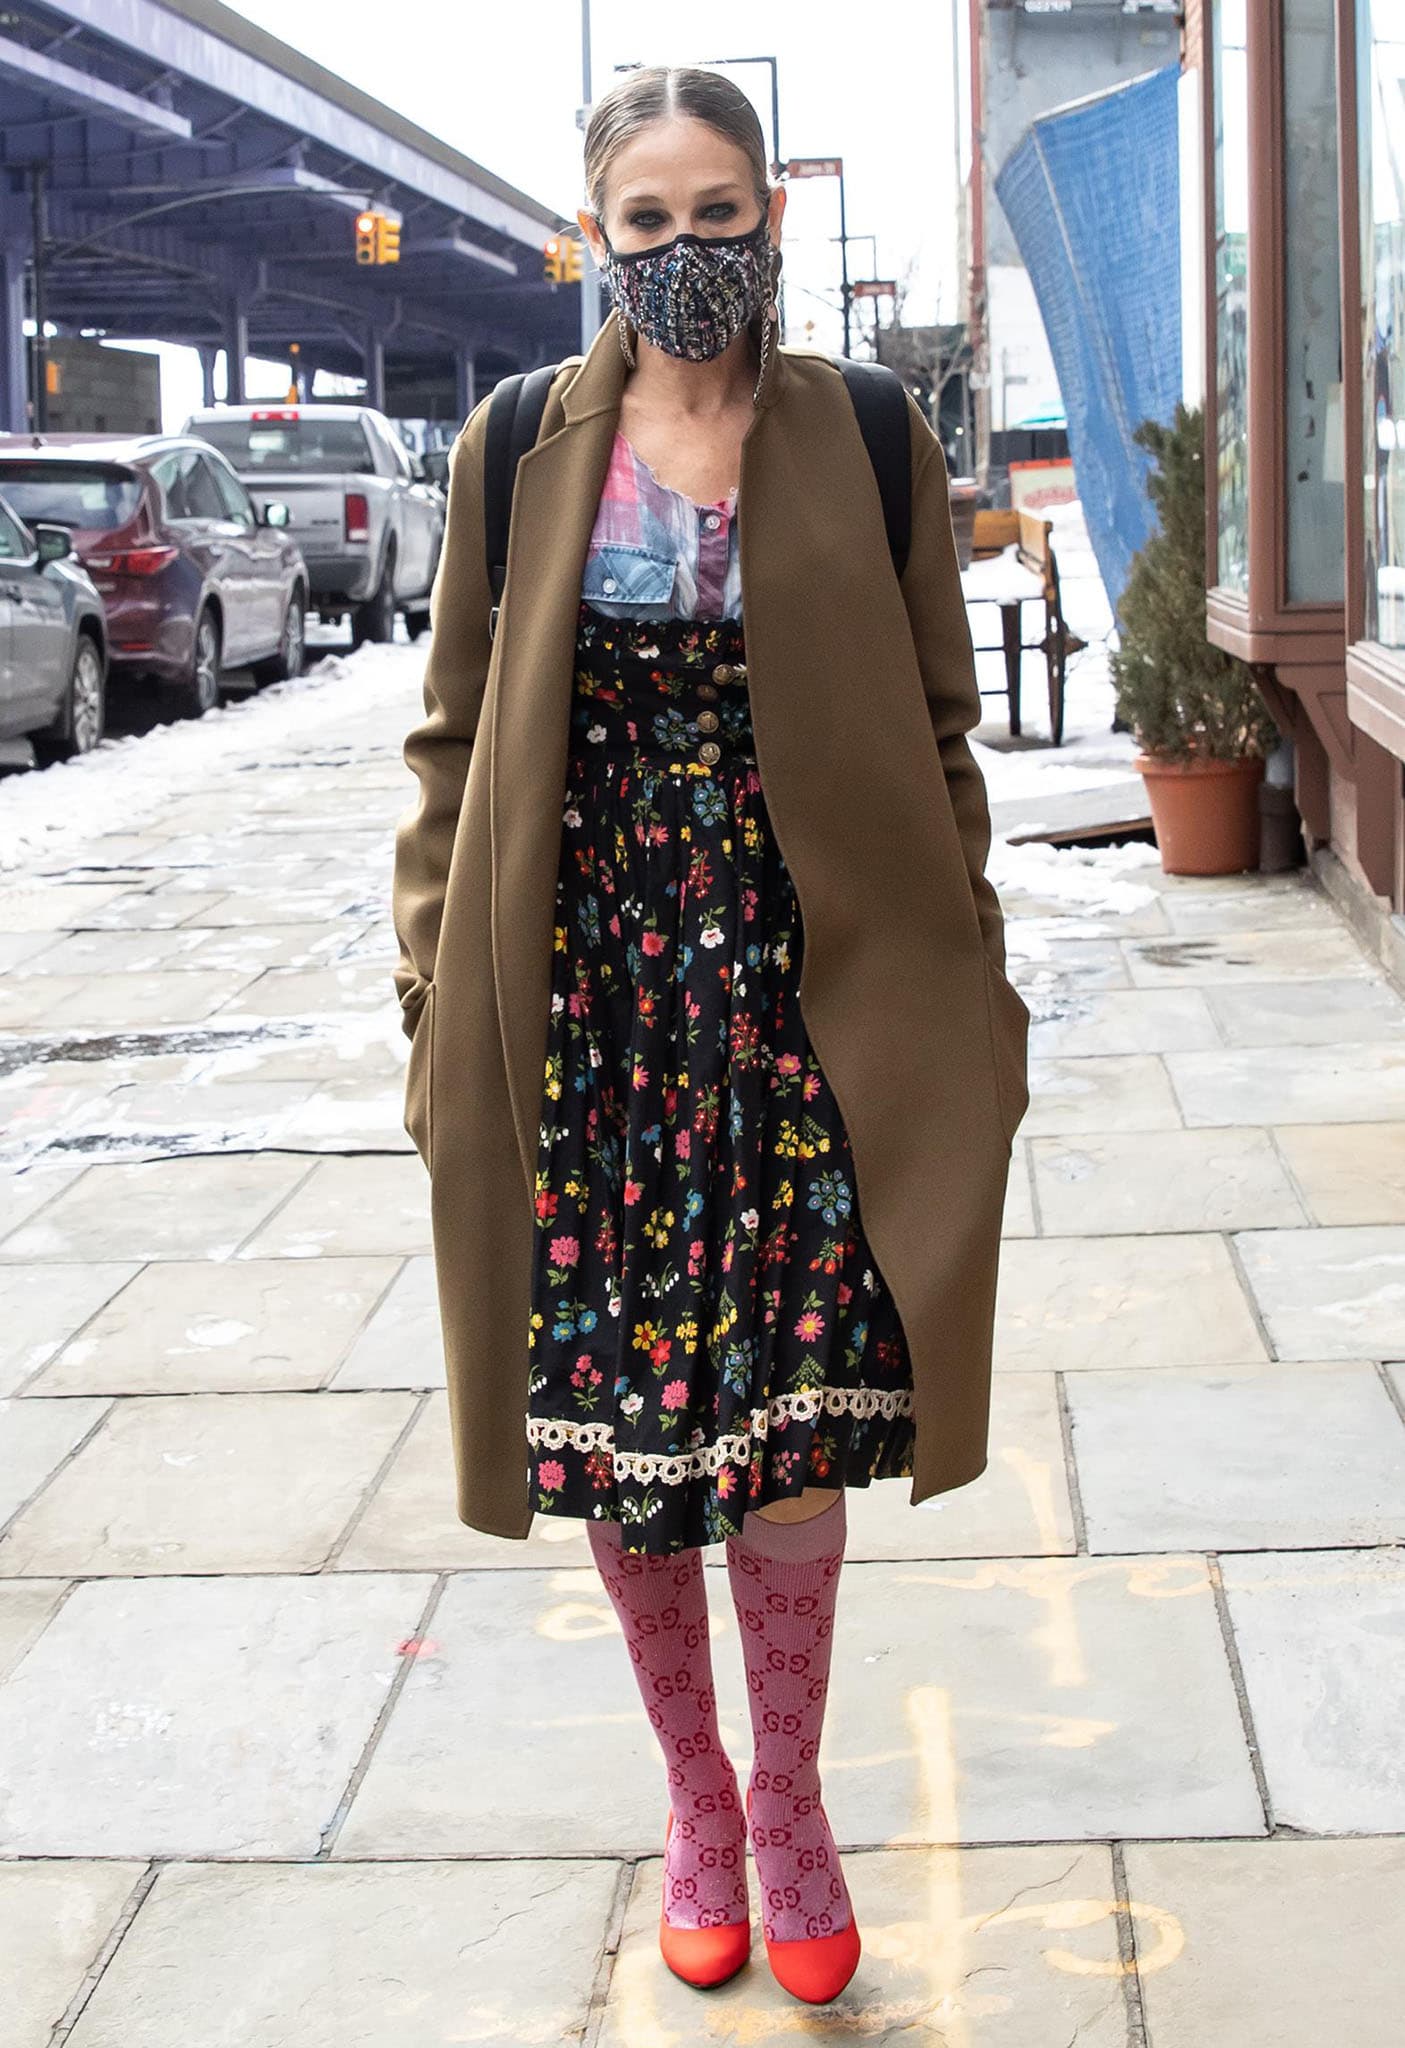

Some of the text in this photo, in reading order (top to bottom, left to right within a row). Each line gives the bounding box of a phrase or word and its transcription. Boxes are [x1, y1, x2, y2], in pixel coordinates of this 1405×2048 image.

[767, 1593, 819, 1616] GG
[635, 1608, 680, 1634] GG
[766, 1649, 810, 1675] GG
[654, 1671, 691, 1697] GG
[763, 1710, 801, 1735] GG
[676, 1732, 711, 1759] GG
[755, 1770, 793, 1793] GG
[695, 1790, 735, 1813] GG
[752, 1827, 792, 1848] GG
[698, 1847, 738, 1869] GG
[799, 1846, 828, 1871] GG
[671, 1878, 697, 1900] GG
[768, 1886, 801, 1911] GG
[806, 1913, 833, 1938] GG
